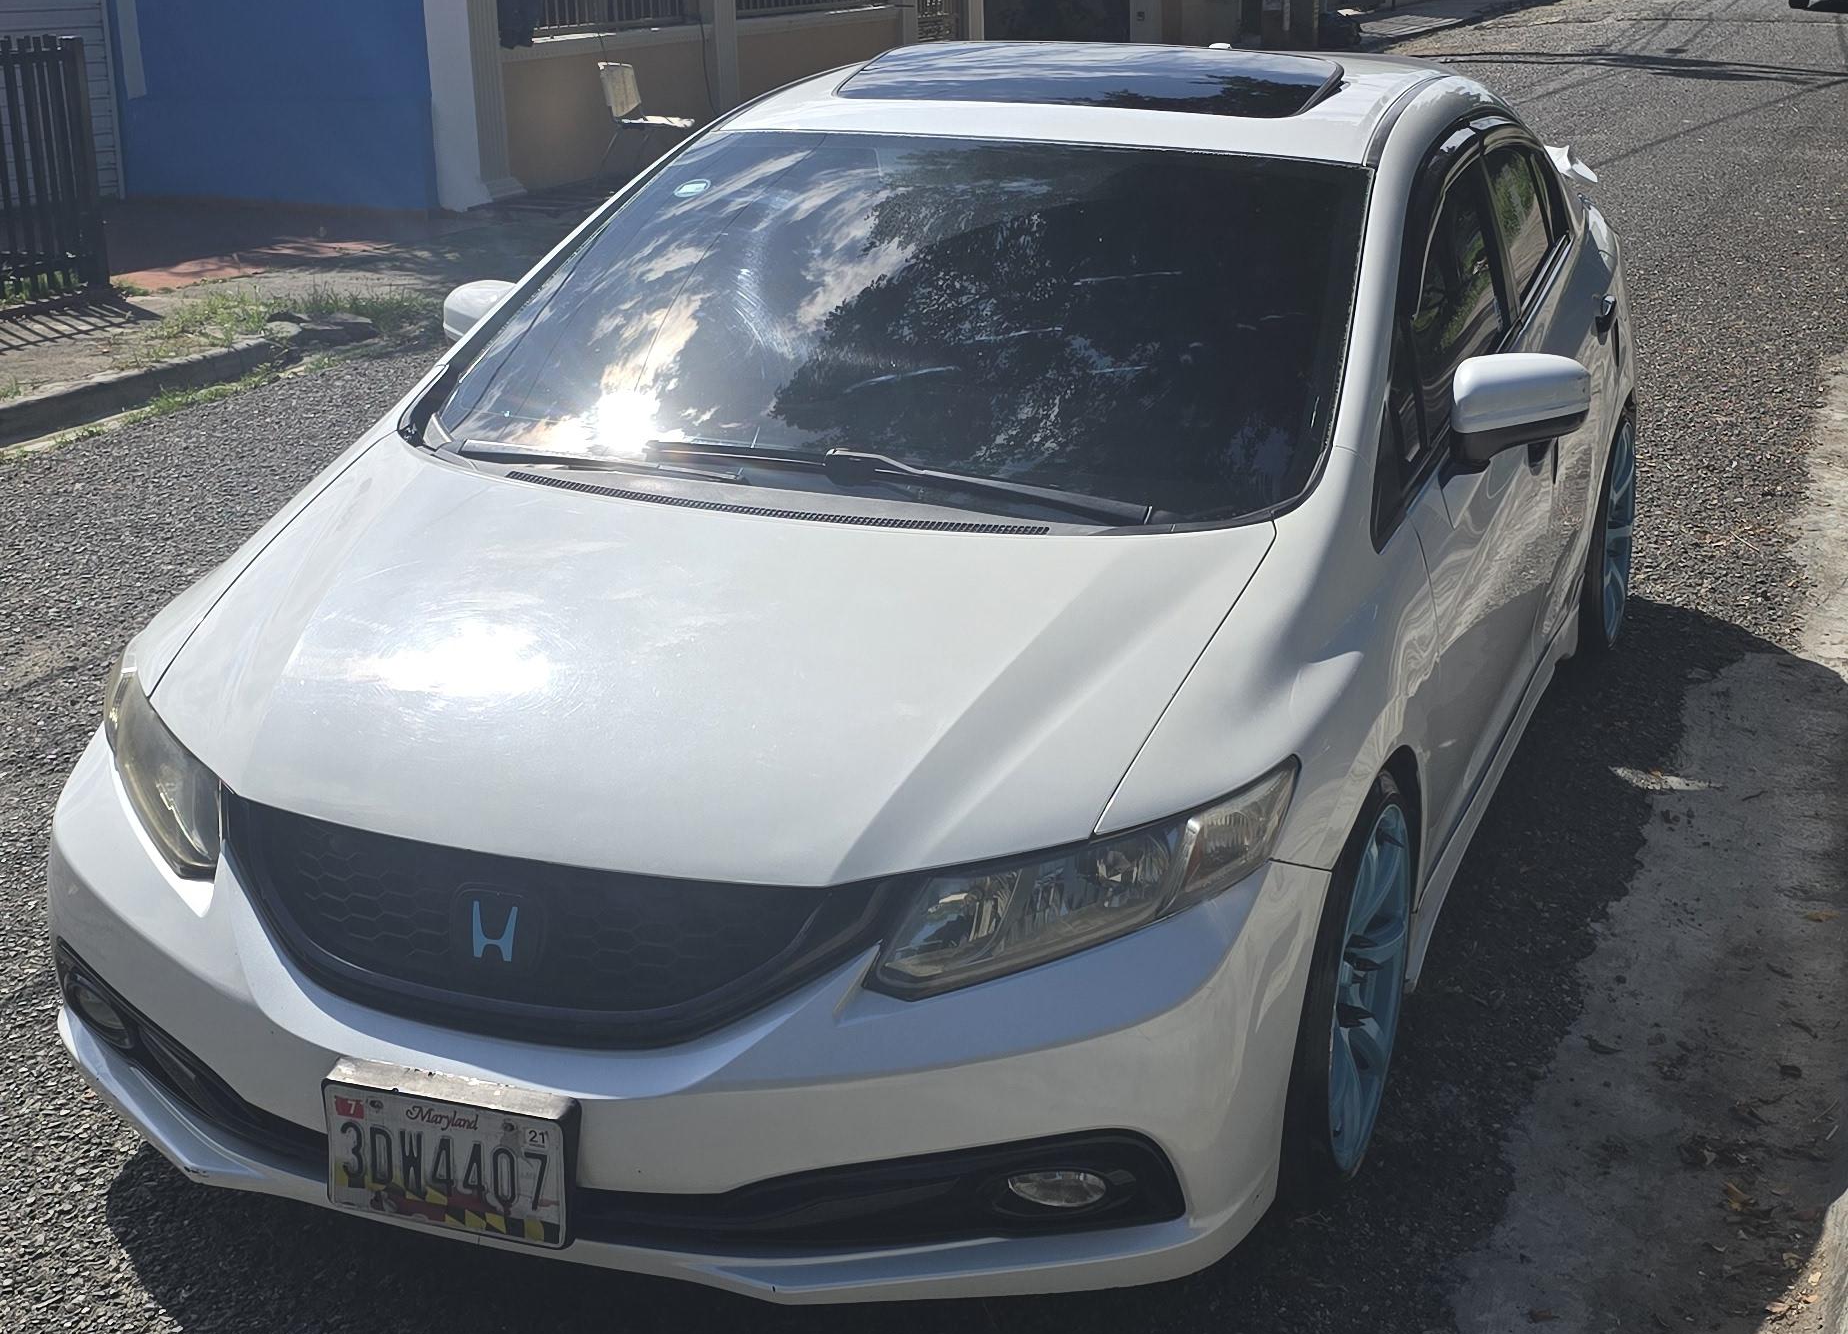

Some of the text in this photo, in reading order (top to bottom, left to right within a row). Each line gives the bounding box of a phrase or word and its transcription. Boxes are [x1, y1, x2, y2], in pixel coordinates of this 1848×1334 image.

[347, 1101, 357, 1114] 7
[406, 1104, 479, 1131] Maryland
[528, 1129, 546, 1144] 21
[340, 1120, 549, 1212] 3DW4407
